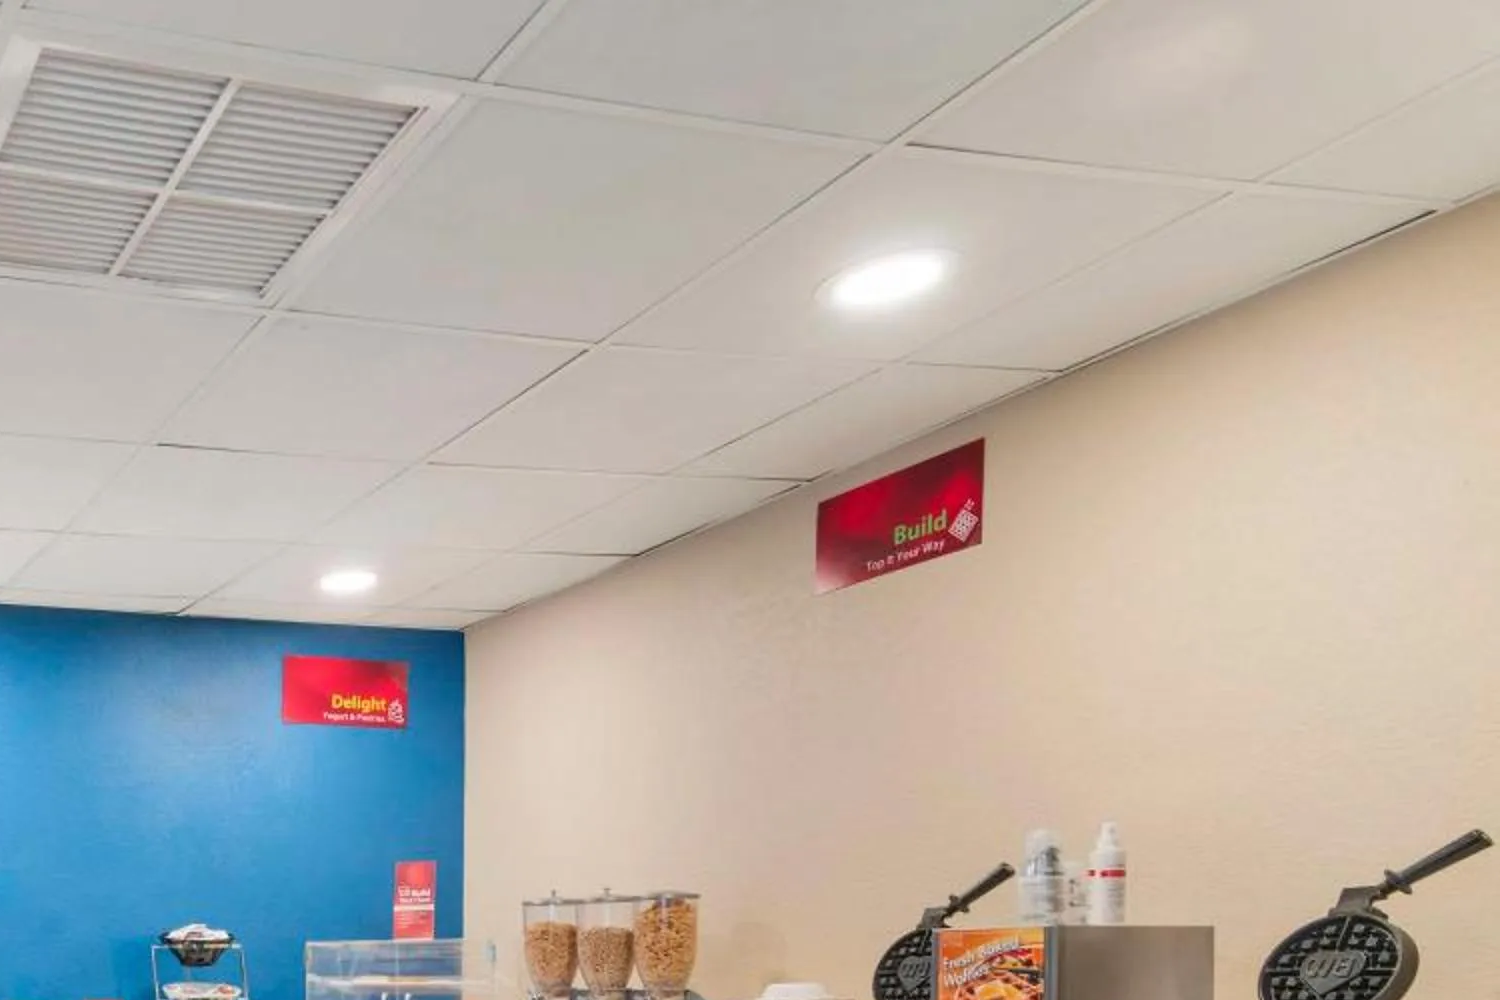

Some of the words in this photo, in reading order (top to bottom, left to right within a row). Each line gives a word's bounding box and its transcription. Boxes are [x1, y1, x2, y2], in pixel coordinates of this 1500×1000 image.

[893, 507, 948, 545] Build
[866, 559, 885, 573] Top
[331, 693, 386, 713] Delight
